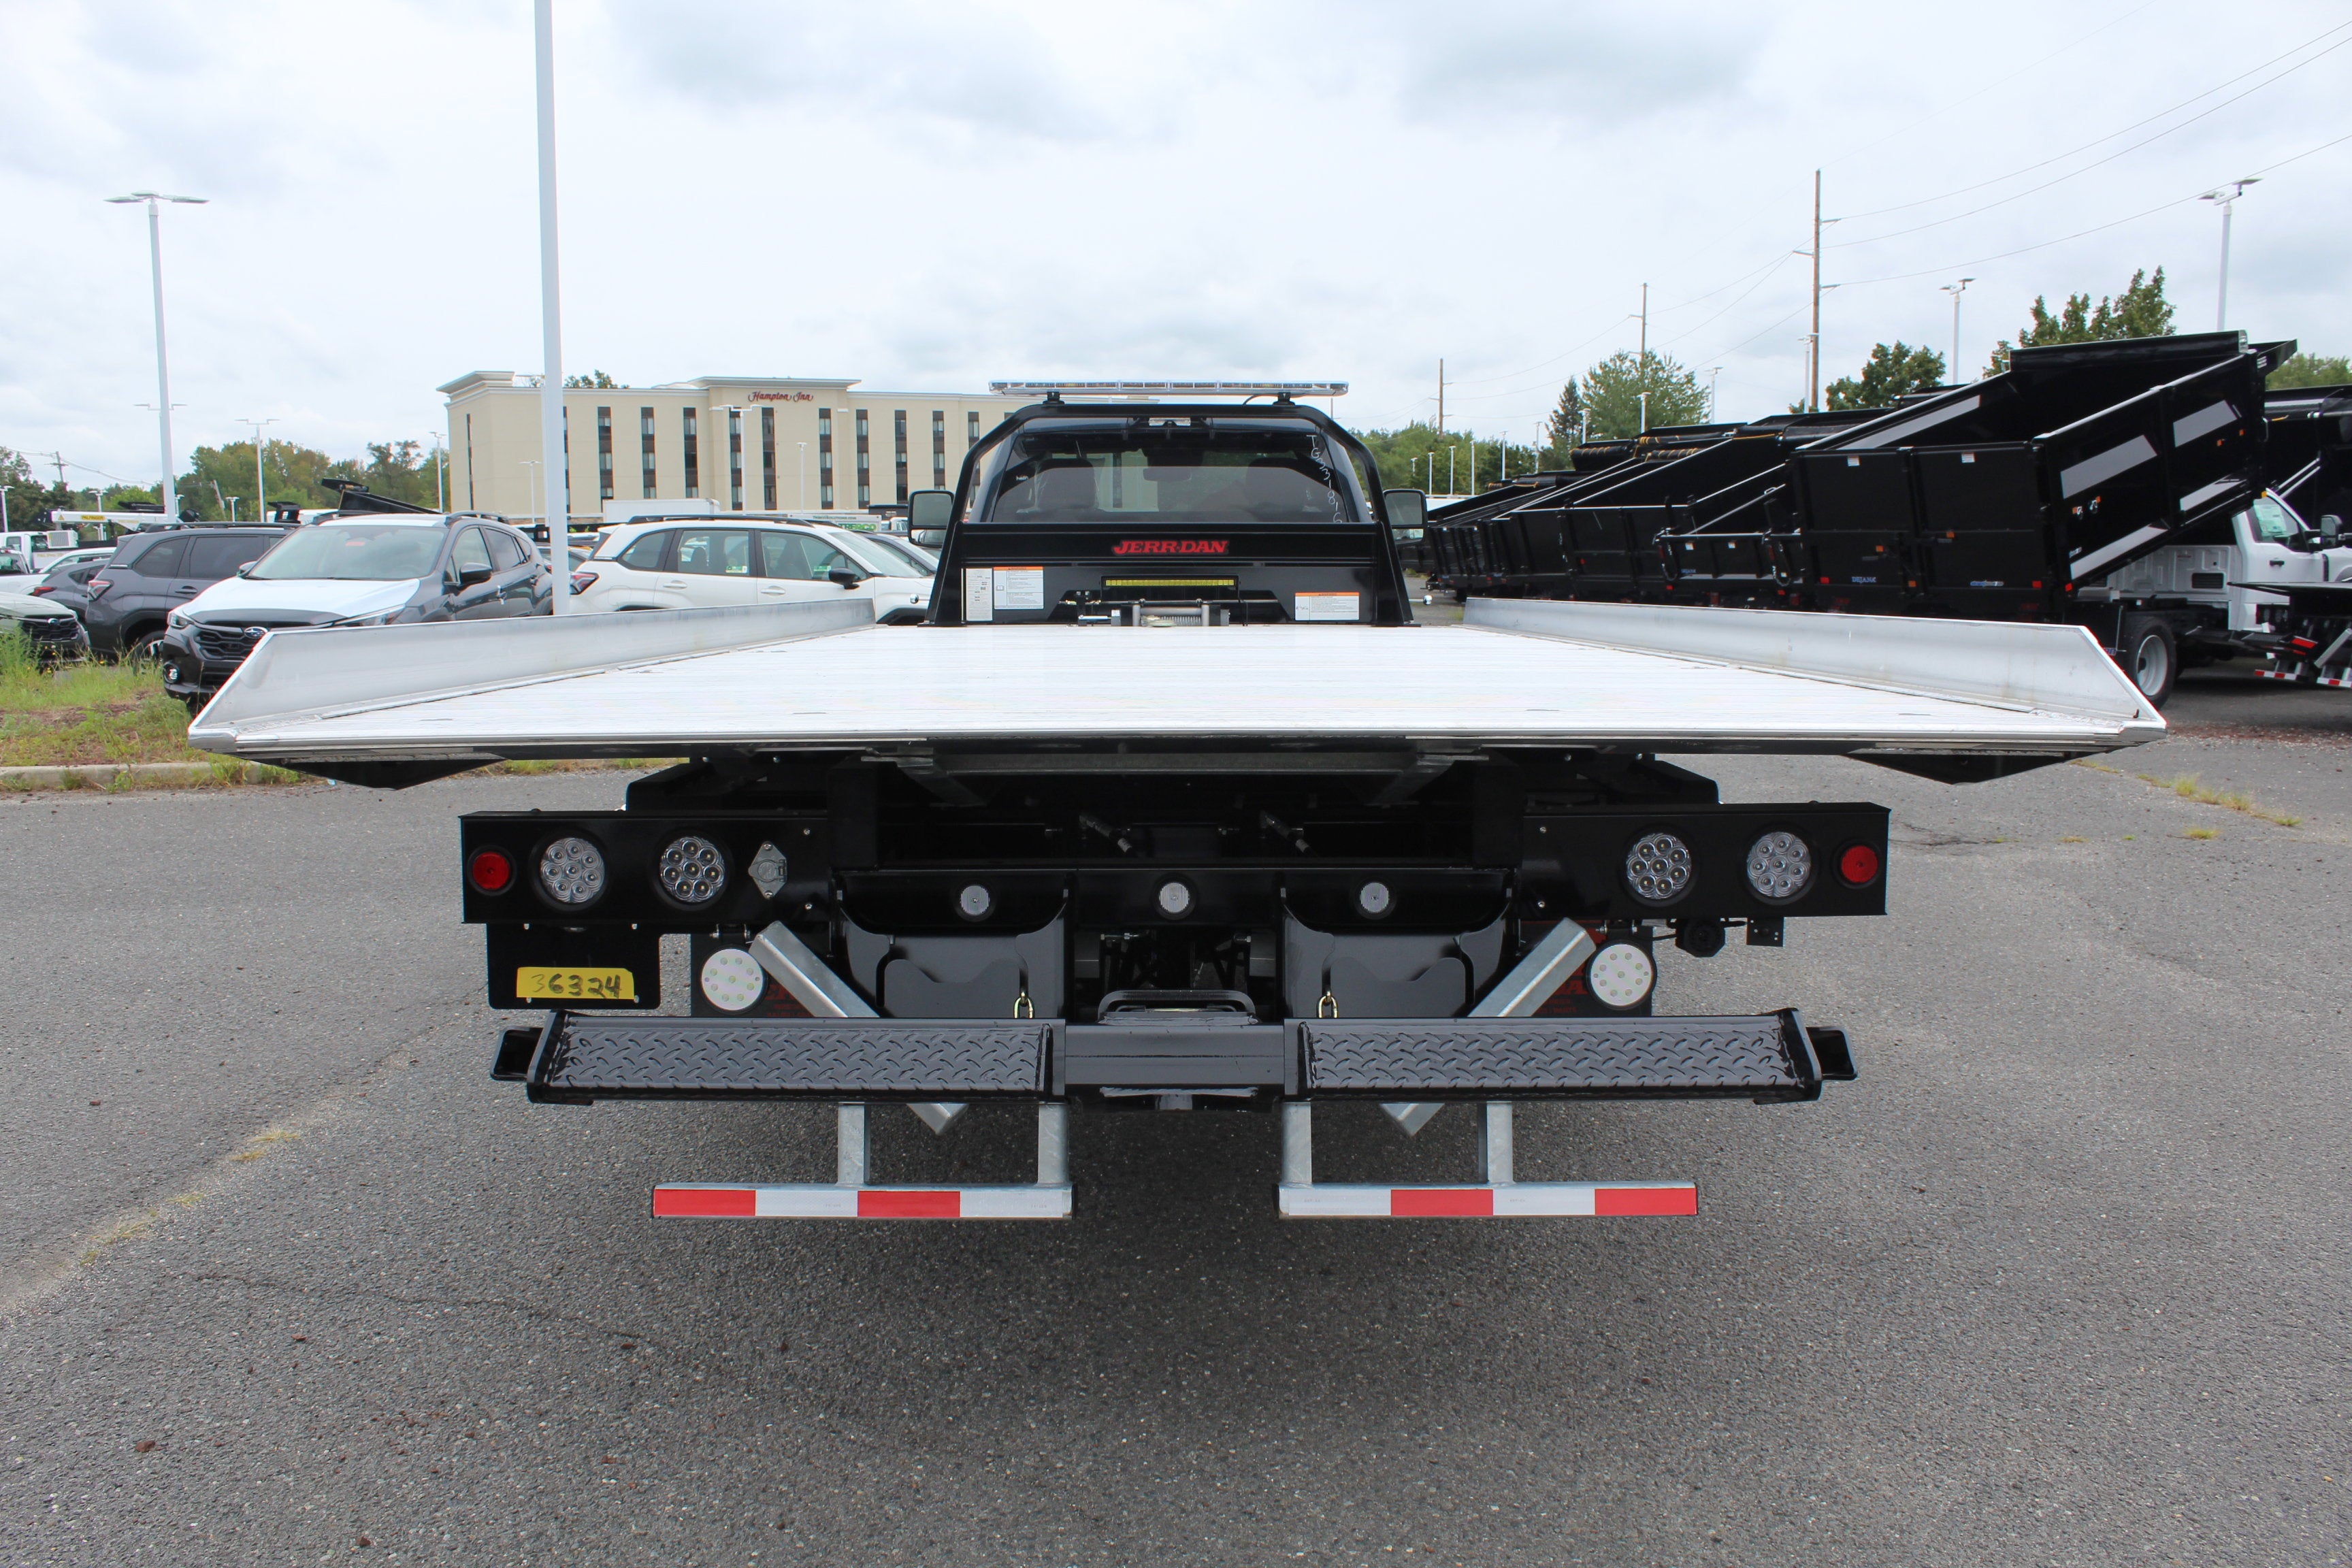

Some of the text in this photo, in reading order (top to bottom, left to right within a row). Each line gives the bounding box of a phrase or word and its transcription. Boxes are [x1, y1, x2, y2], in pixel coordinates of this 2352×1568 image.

[748, 391, 814, 403] Hampton Inn
[531, 973, 622, 998] 36324
